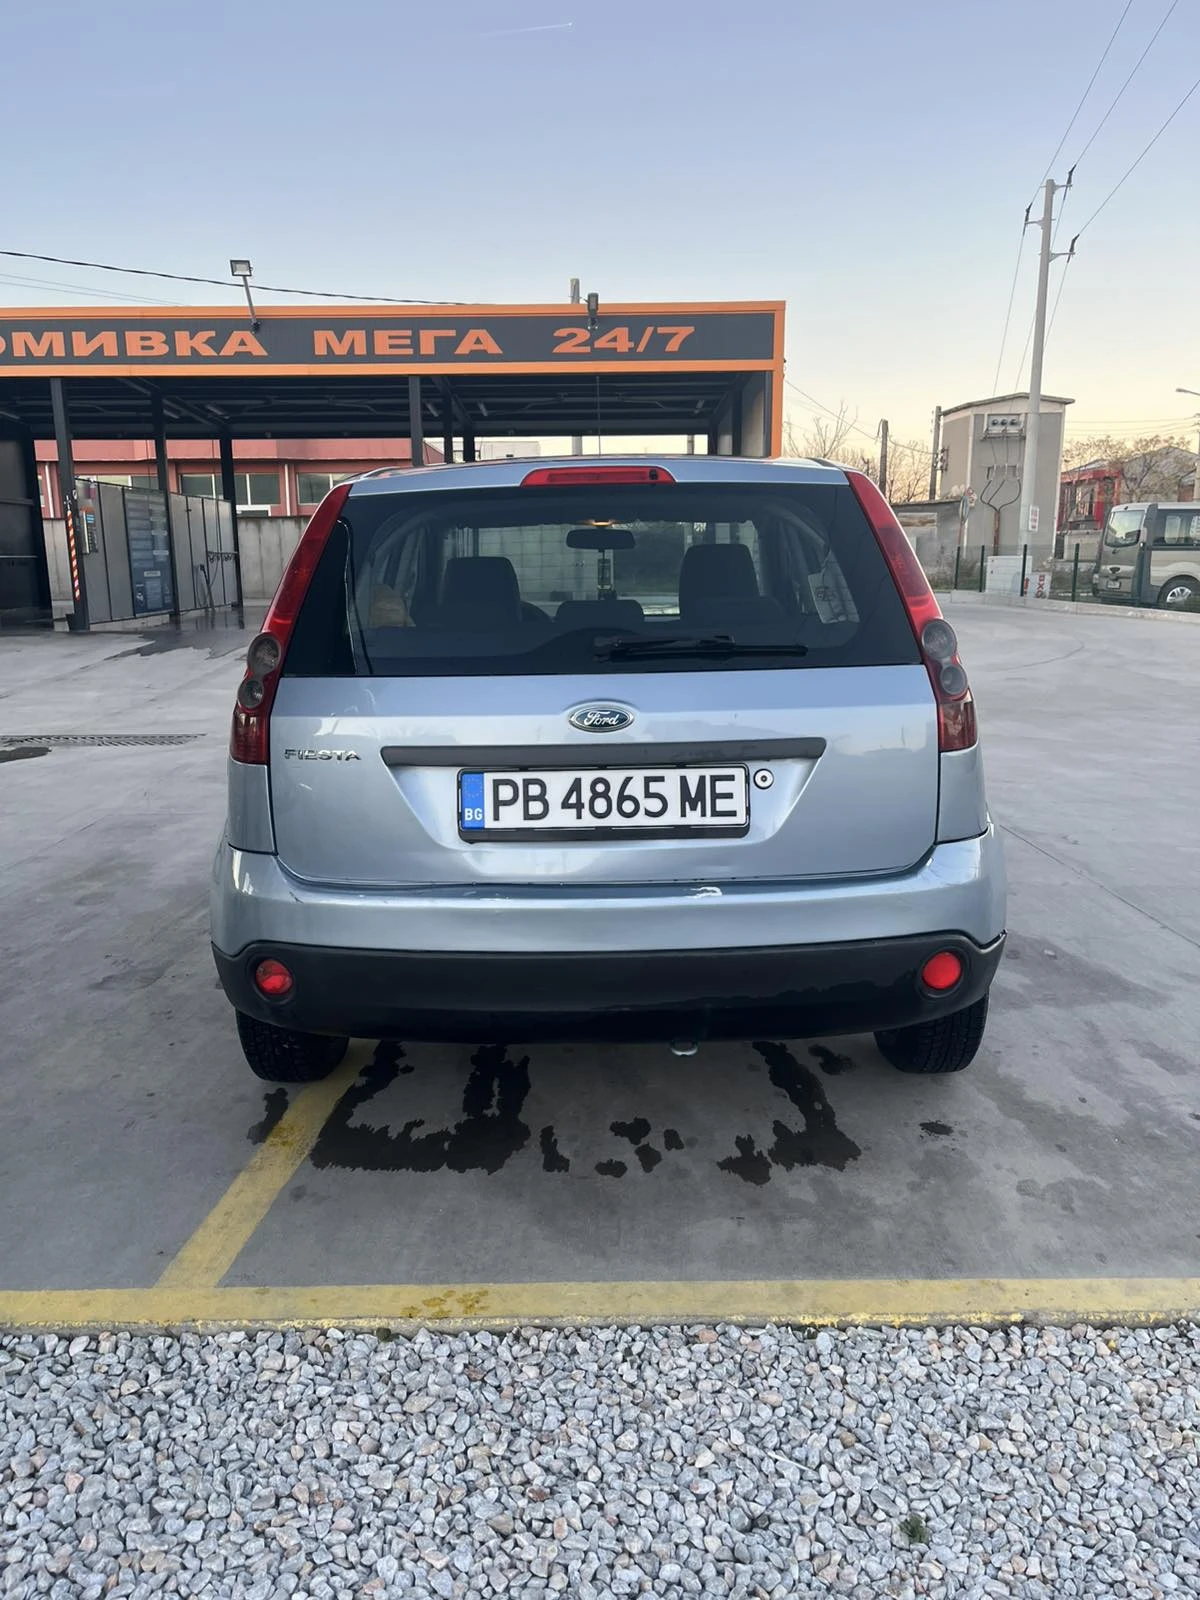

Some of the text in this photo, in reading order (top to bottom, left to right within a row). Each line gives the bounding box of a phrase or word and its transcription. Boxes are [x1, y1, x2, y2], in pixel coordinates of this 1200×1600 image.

[0, 326, 696, 357] МИВКА МЕГА 24/7
[583, 710, 620, 726] Ford
[284, 749, 362, 761] FIESTA
[492, 774, 737, 821] PB 4865 ME
[464, 808, 483, 821] BG
